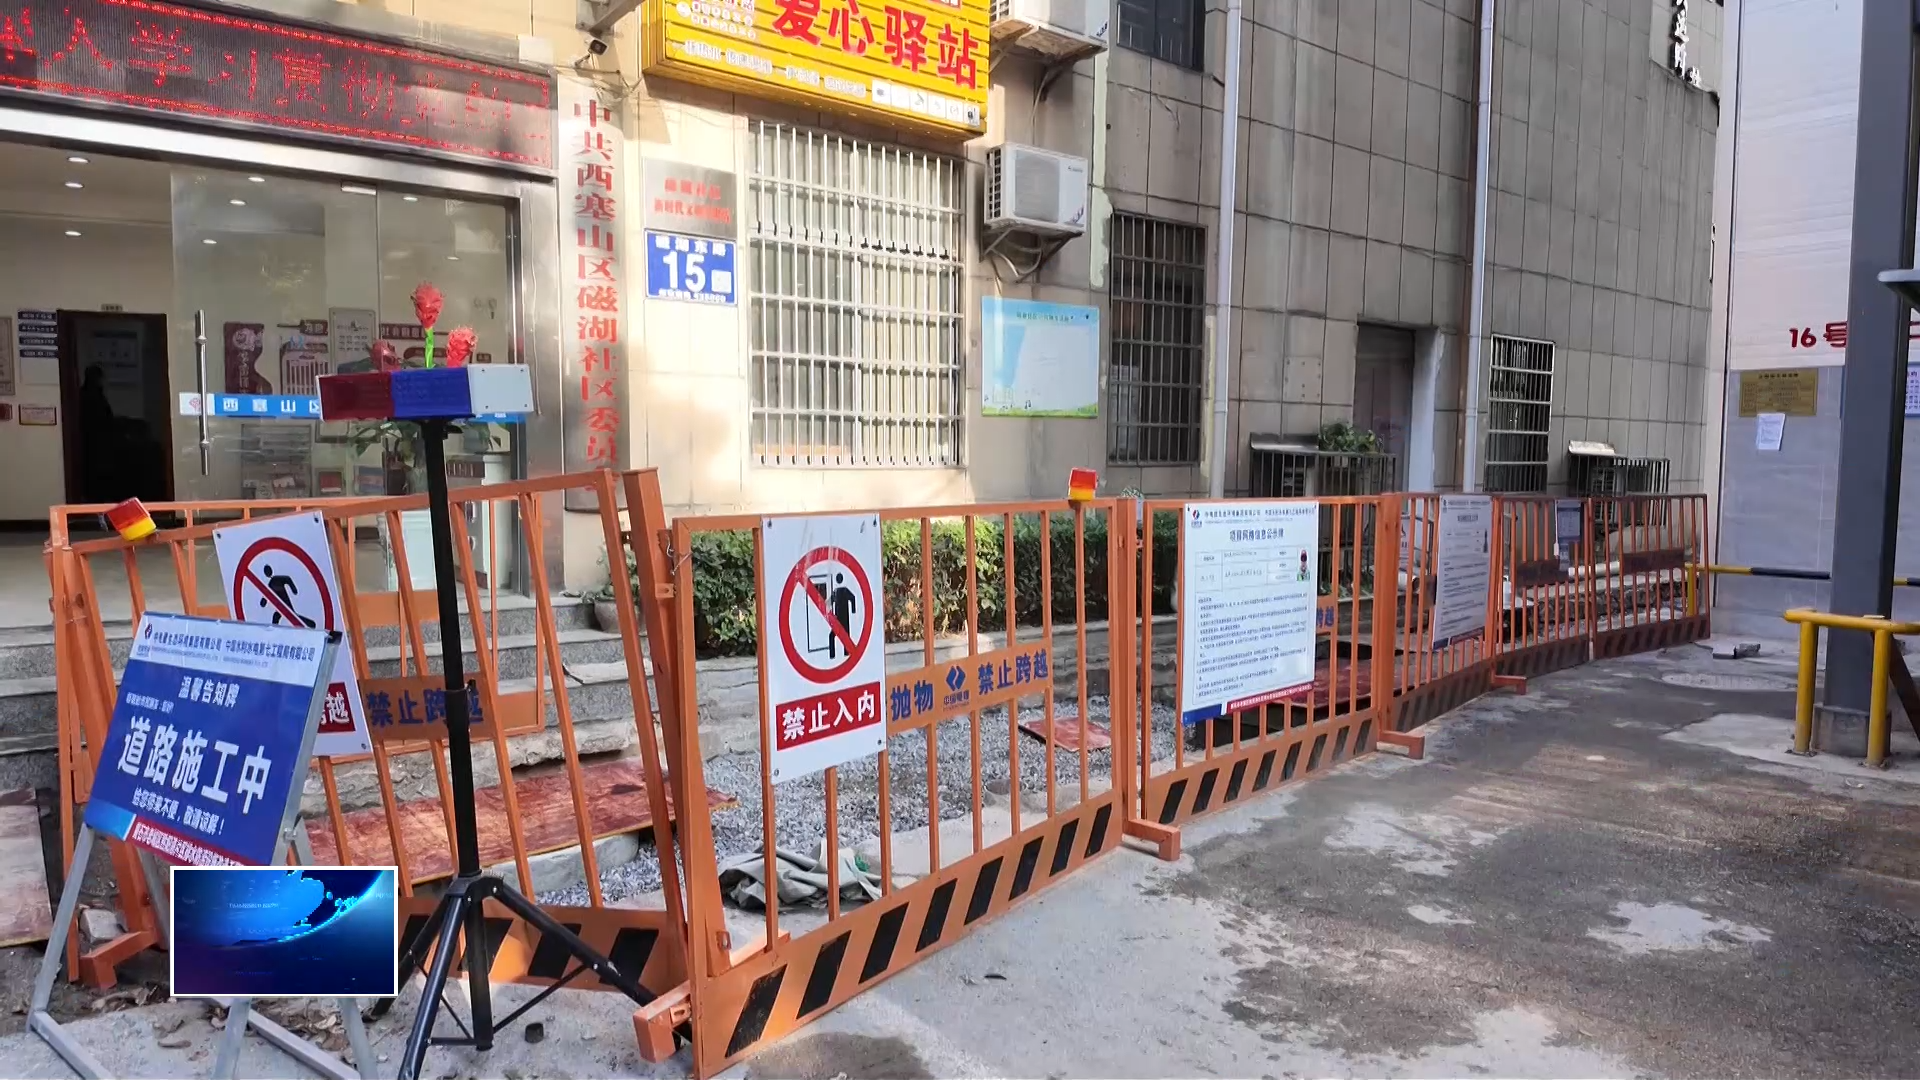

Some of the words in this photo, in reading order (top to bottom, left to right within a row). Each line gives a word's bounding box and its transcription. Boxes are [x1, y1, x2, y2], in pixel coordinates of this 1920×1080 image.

[772, 0, 979, 90] 爱心驿站
[662, 250, 706, 292] 15
[178, 674, 240, 709] 温馨告知牌
[977, 648, 1049, 695] 禁止跨越
[782, 689, 875, 741] 禁止入内
[889, 679, 934, 722] 抛物
[117, 715, 272, 815] 道路施工中
